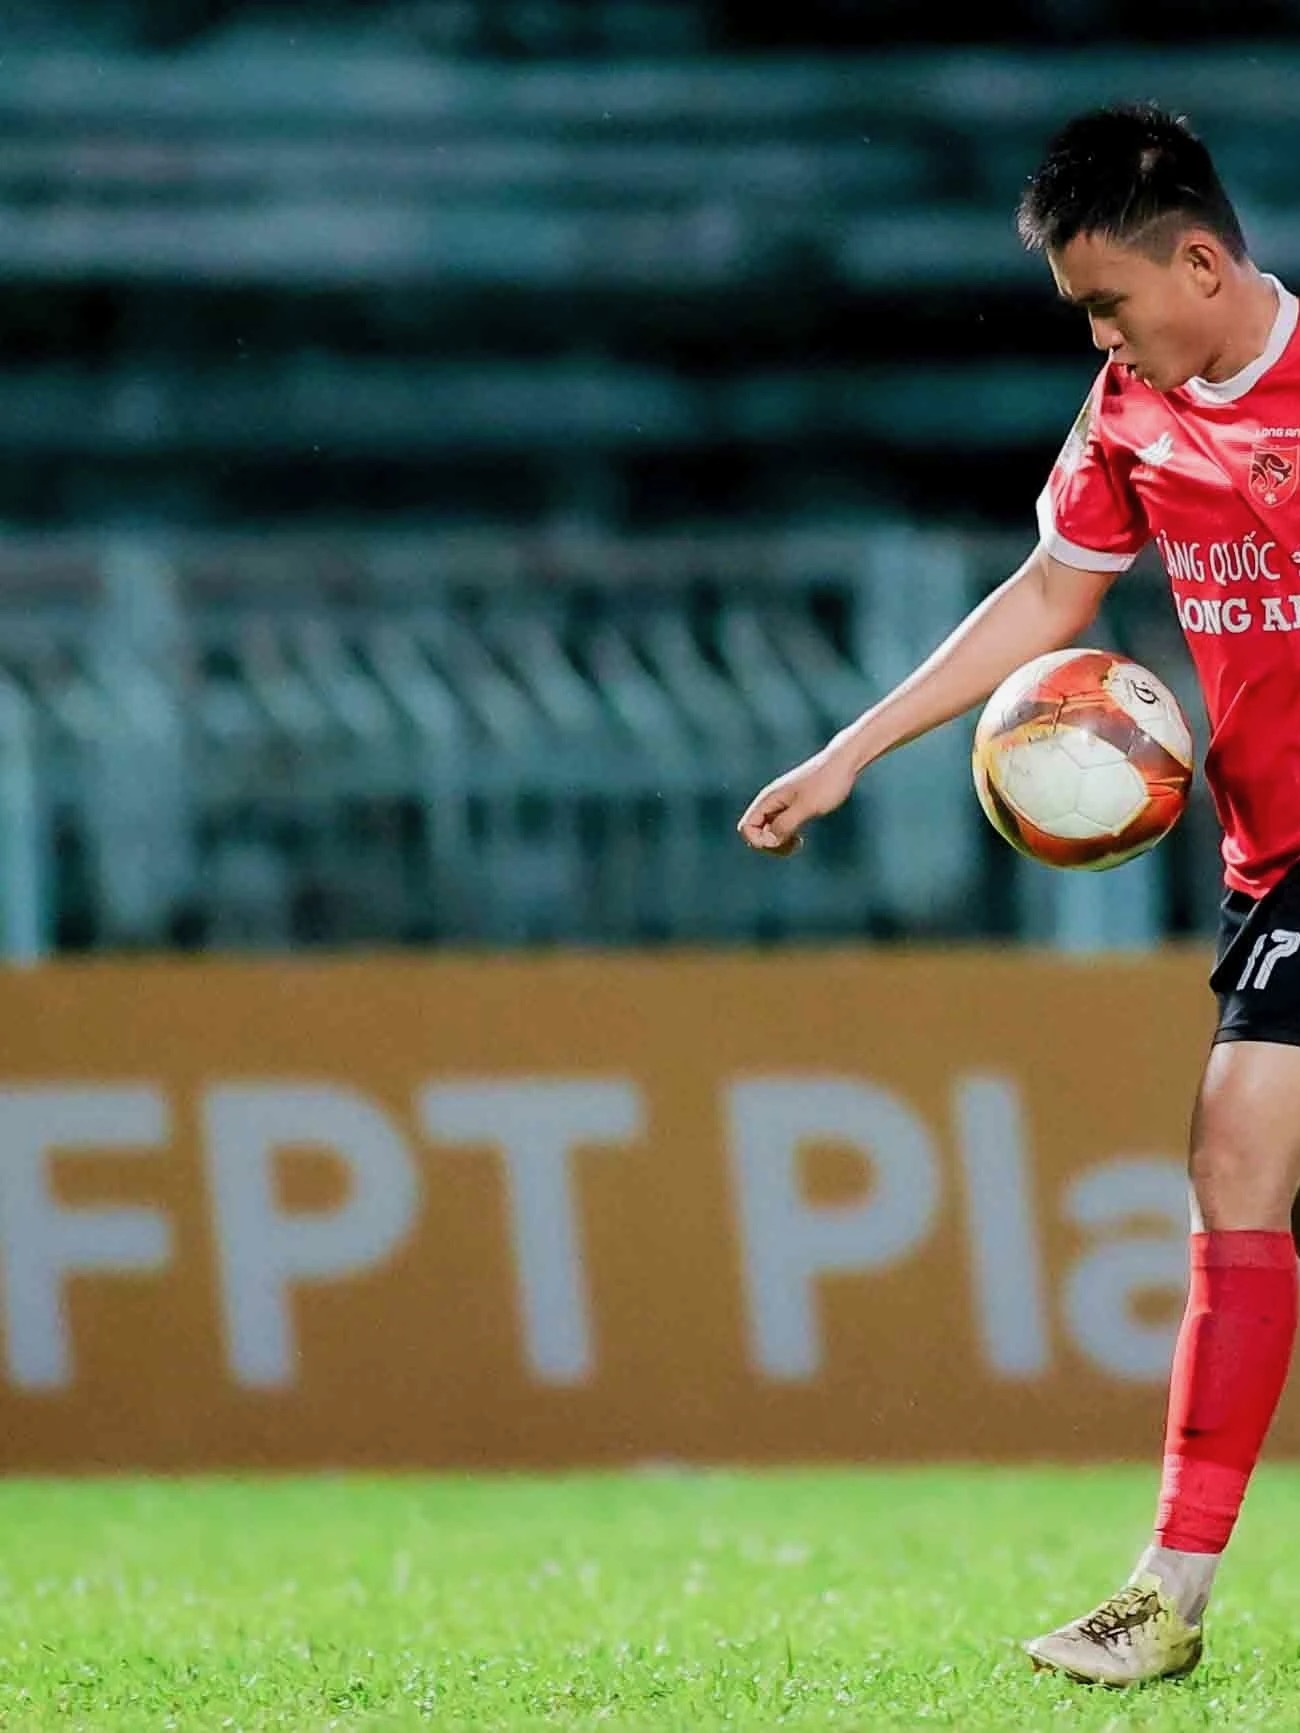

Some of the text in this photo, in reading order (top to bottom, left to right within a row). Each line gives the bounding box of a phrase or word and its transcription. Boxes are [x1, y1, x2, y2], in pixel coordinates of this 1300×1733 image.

[1155, 529, 1205, 583] ẢNG
[1209, 530, 1281, 587] QUỐC
[0, 1078, 646, 1392] FPT
